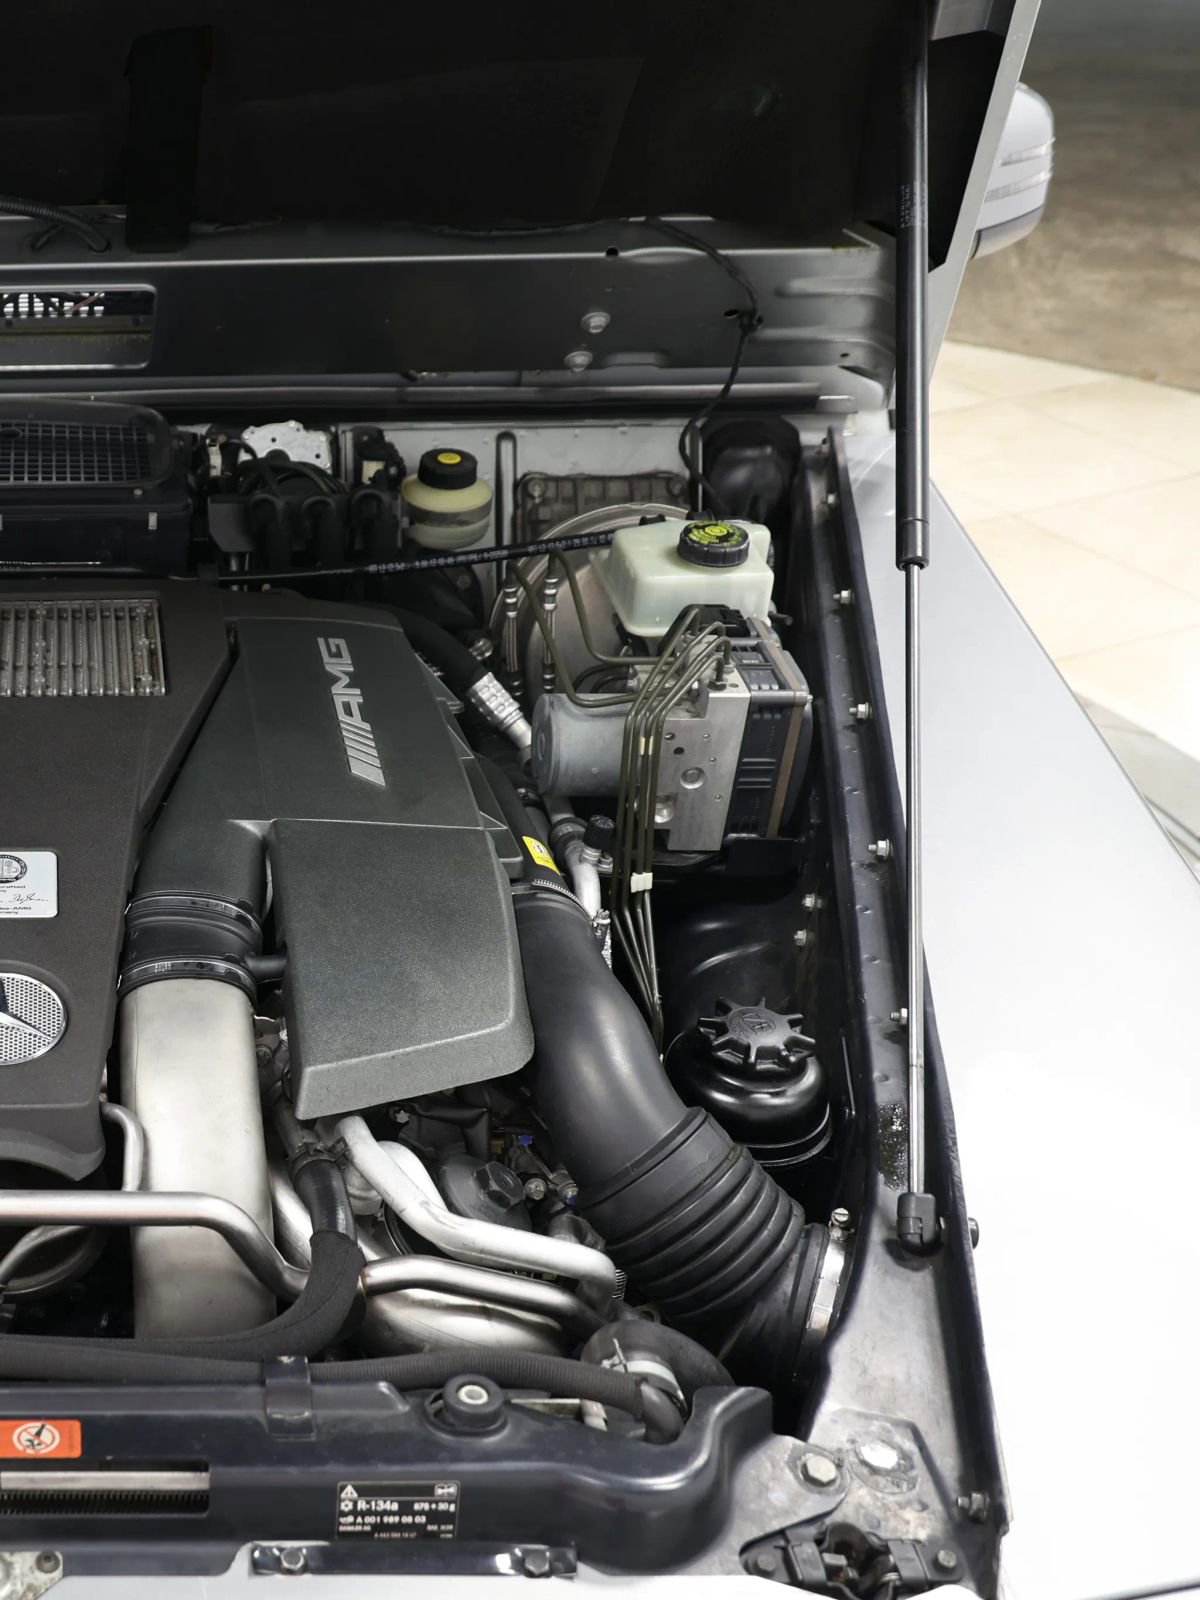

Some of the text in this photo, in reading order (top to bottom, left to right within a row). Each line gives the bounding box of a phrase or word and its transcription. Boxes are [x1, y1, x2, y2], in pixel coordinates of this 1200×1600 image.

[317, 637, 372, 731] AMG
[357, 1500, 399, 1512] R-134a
[356, 1516, 363, 1524] A
